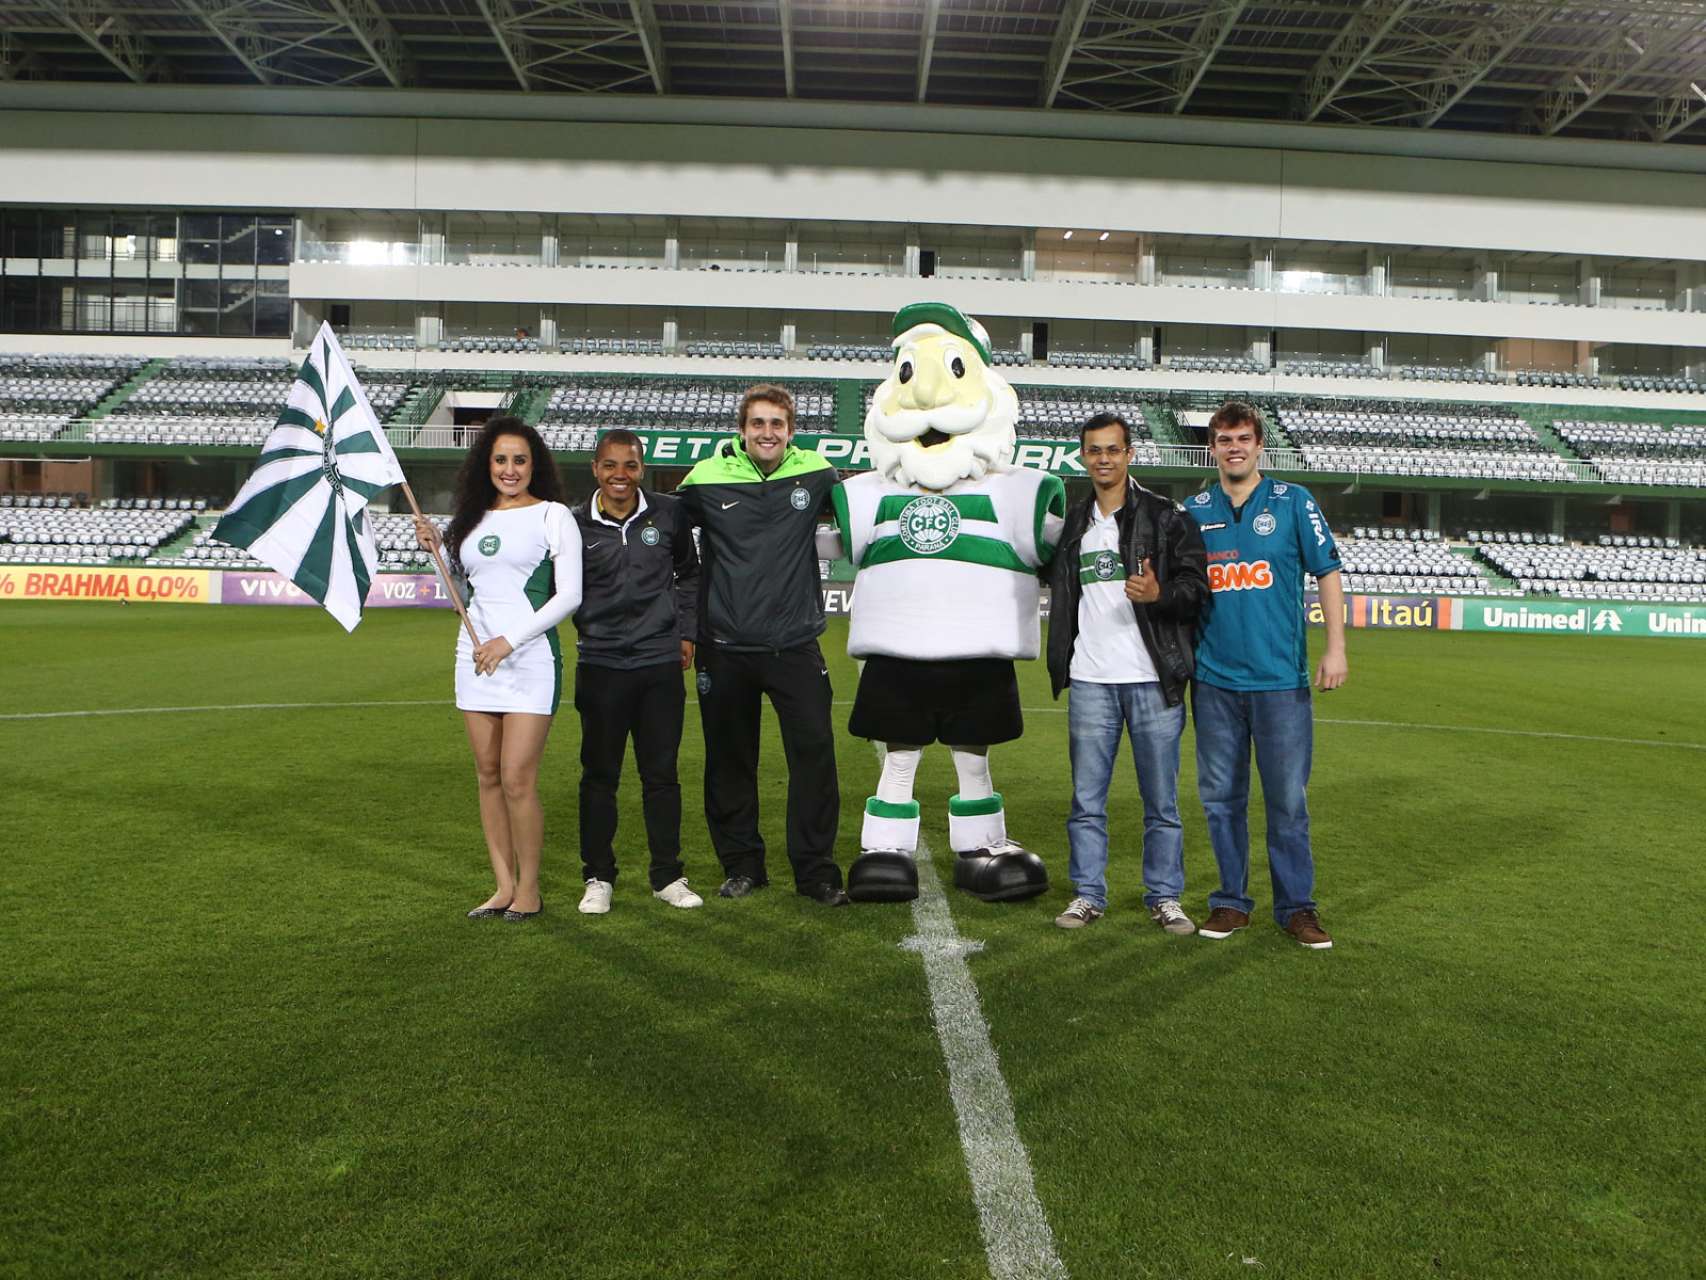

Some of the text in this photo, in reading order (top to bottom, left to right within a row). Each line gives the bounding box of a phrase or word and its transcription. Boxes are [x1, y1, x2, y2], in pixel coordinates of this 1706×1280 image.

[911, 515, 947, 531] CFC
[24, 573, 130, 597] BRAHMA
[136, 575, 199, 600] 0,0%
[1207, 560, 1272, 592] BMG
[382, 582, 416, 599] VOZ
[1371, 598, 1433, 627] Itaú
[1483, 606, 1585, 630] Unimed
